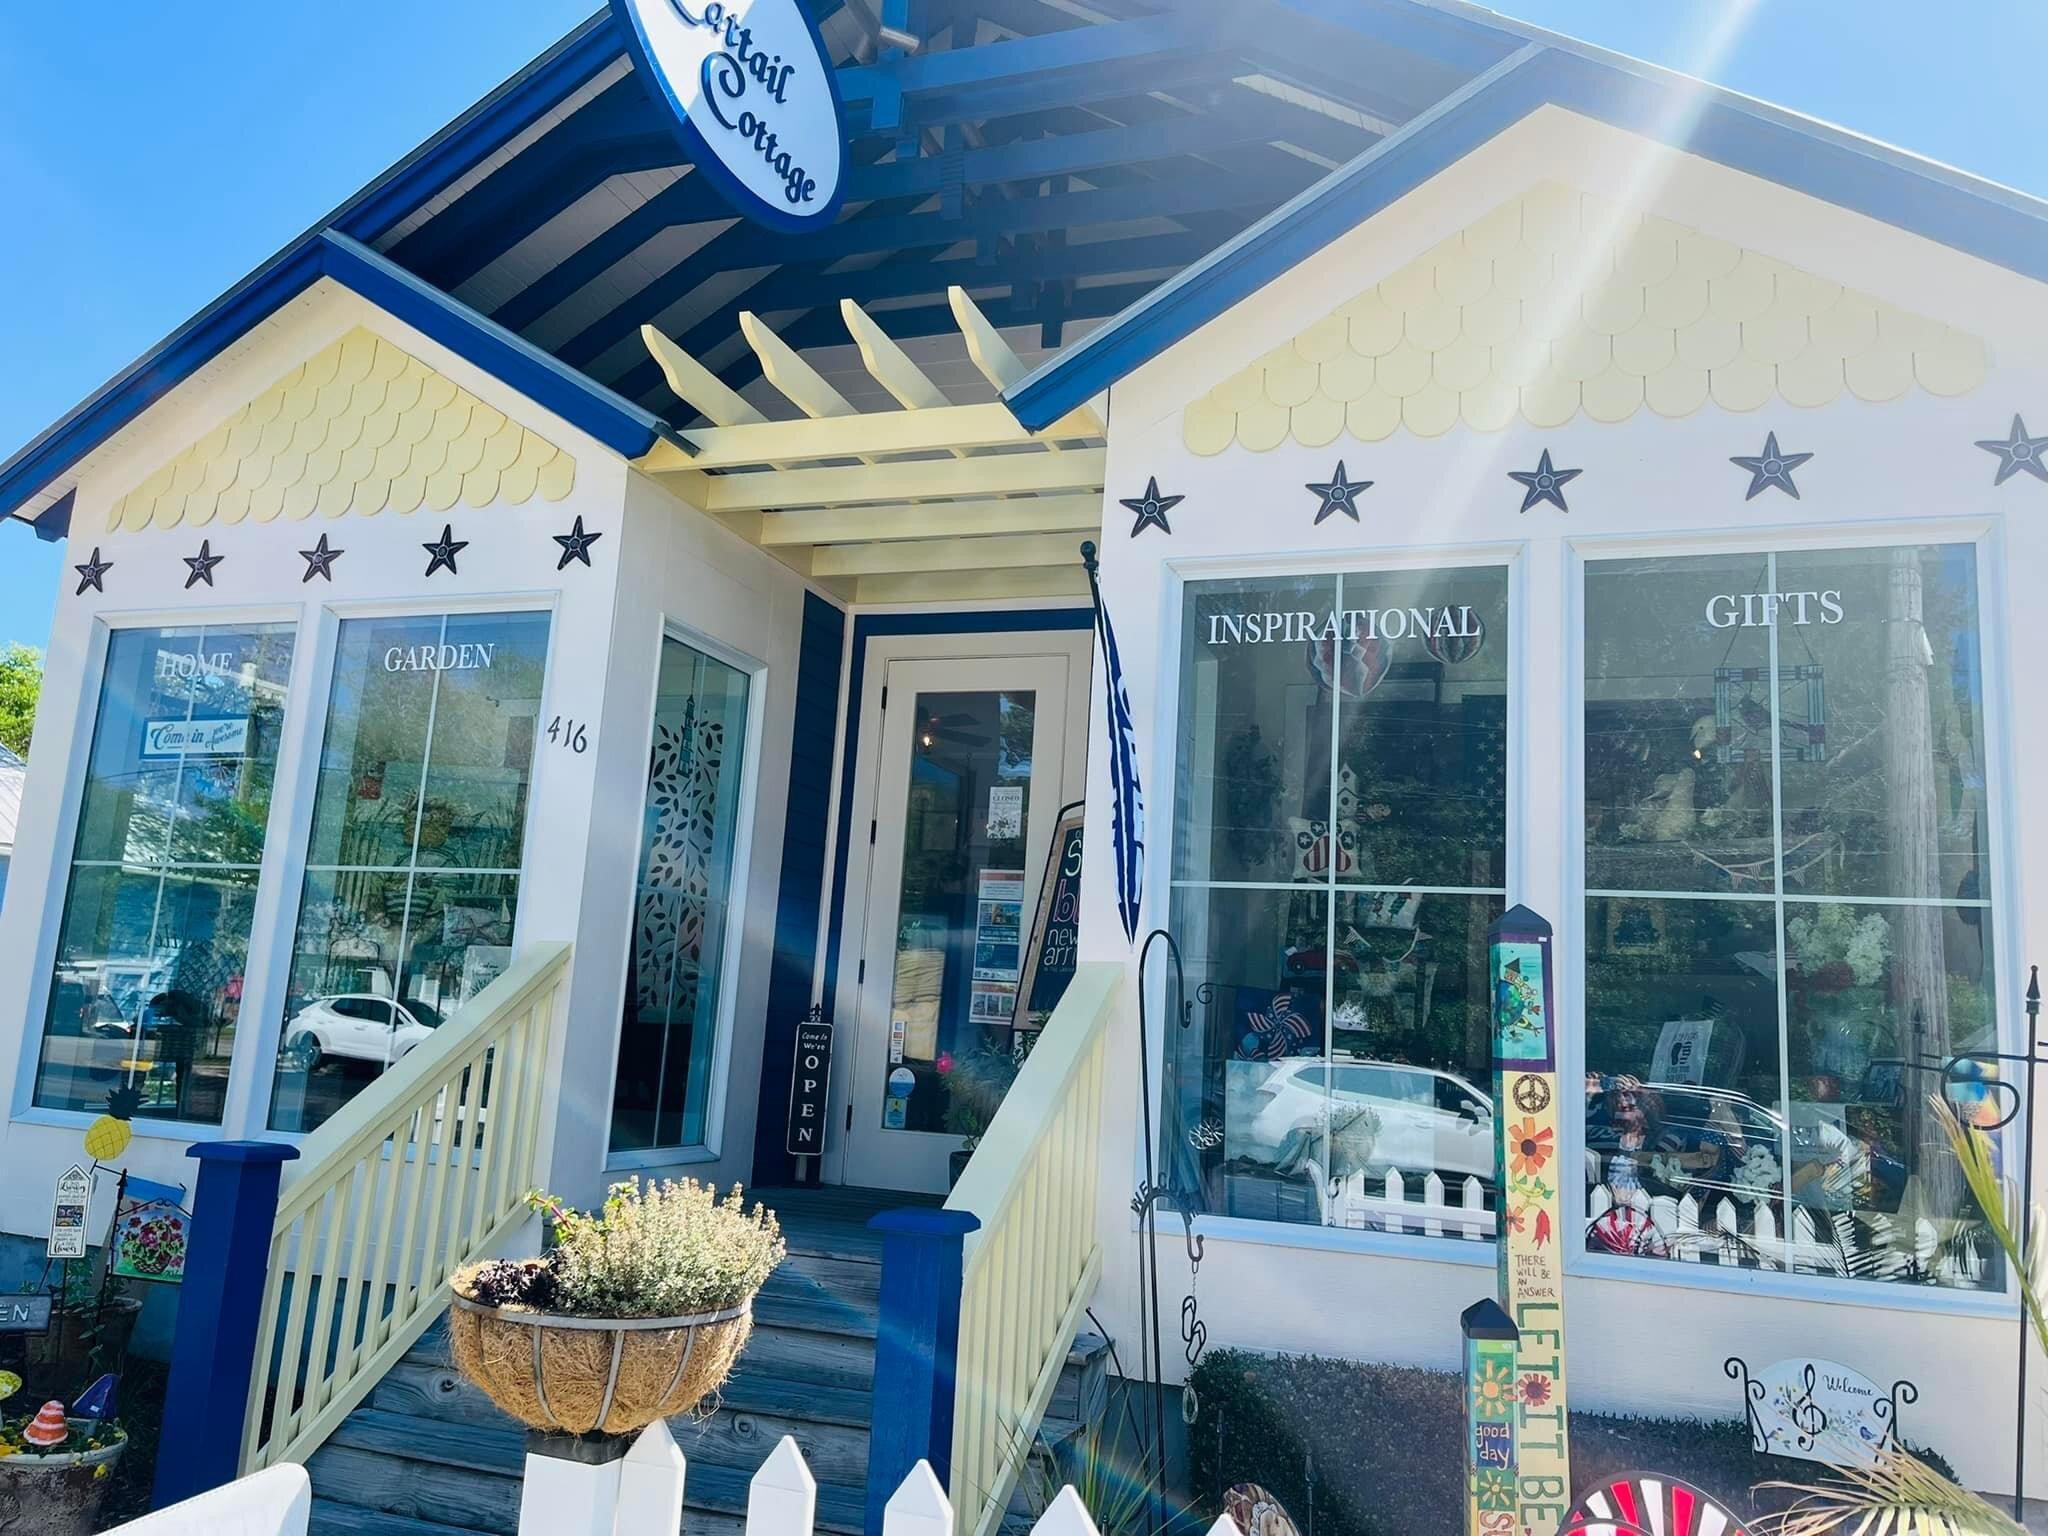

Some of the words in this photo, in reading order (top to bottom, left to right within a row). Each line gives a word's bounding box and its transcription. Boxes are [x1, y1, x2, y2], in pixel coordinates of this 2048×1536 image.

[701, 51, 816, 204] Cottage
[1705, 590, 1844, 628] GIFTS
[1207, 605, 1481, 645] INSPIRATIONAL
[160, 652, 233, 677] HOME
[384, 643, 495, 672] GARDEN
[191, 728, 205, 743] in
[547, 715, 588, 754] 416
[798, 1055, 819, 1142] OPEN
[1515, 1254, 1546, 1267] THERE
[1516, 1267, 1537, 1278] WILL
[1541, 1270, 1551, 1280] BE
[1517, 1278, 1528, 1287] AN
[1517, 1286, 1556, 1299] ANSWER
[1516, 1303, 1561, 1380] LET
[1823, 1374, 1874, 1397] Welcome
[1475, 1421, 1510, 1448] good
[1518, 1401, 1565, 1459] IT
[1479, 1441, 1509, 1471] day
[1519, 1475, 1565, 1526] BE
